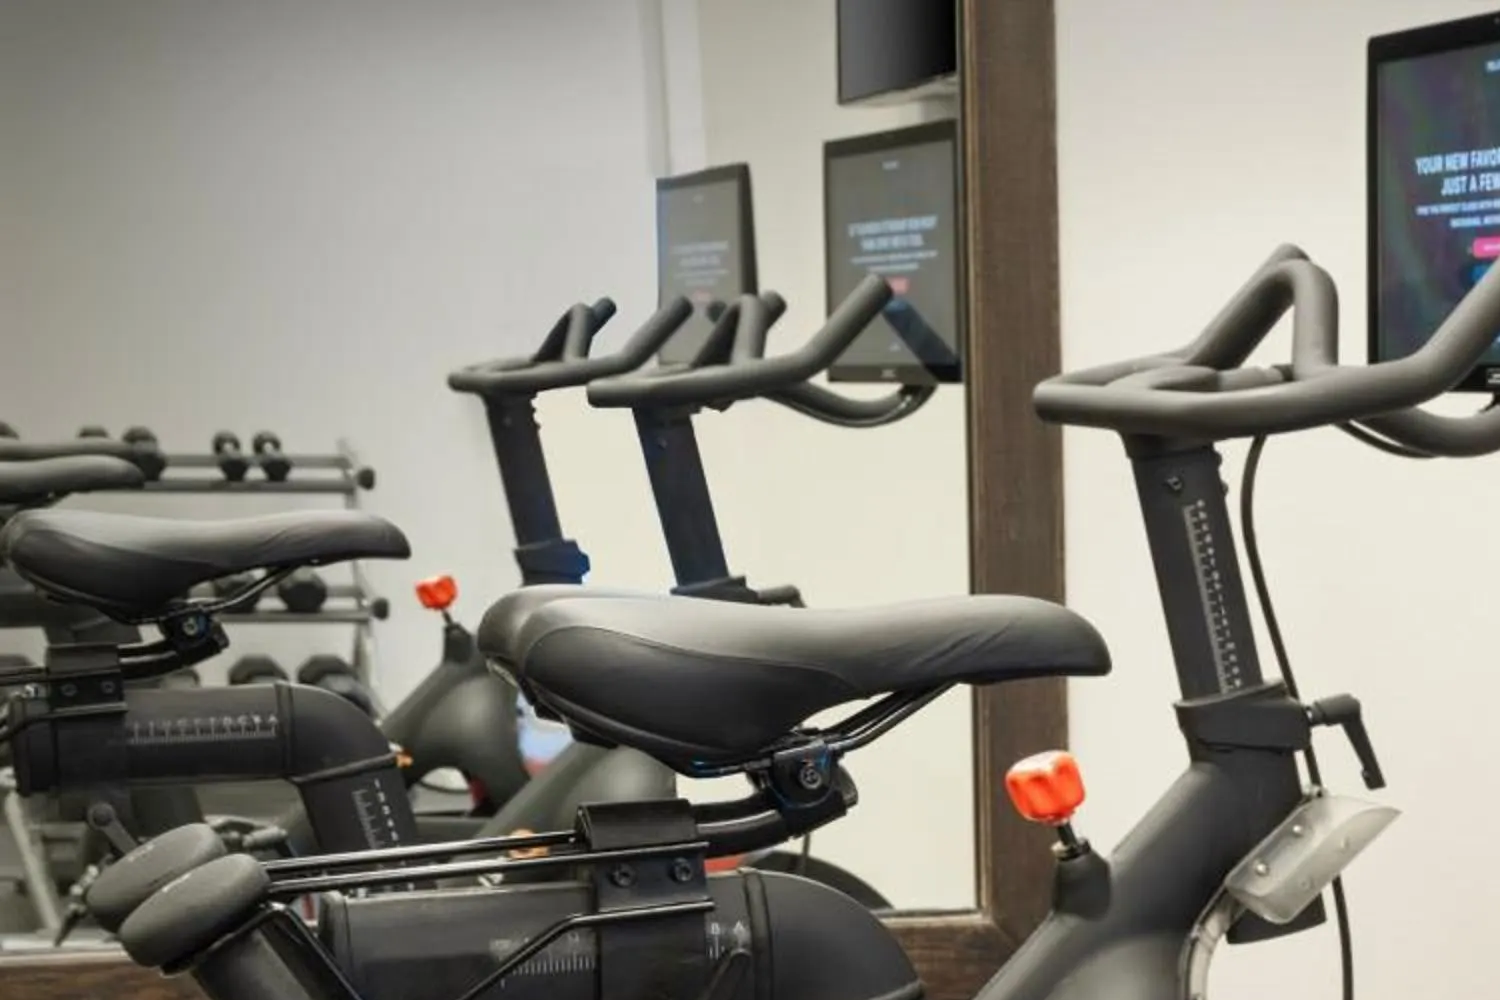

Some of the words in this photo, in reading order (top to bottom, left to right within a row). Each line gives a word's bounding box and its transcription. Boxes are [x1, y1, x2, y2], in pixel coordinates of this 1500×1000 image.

[1415, 154, 1443, 175] YOUR
[1445, 151, 1469, 171] NEW
[1441, 175, 1467, 196] JUST
[1469, 174, 1477, 193] A
[1479, 172, 1500, 192] FEW
